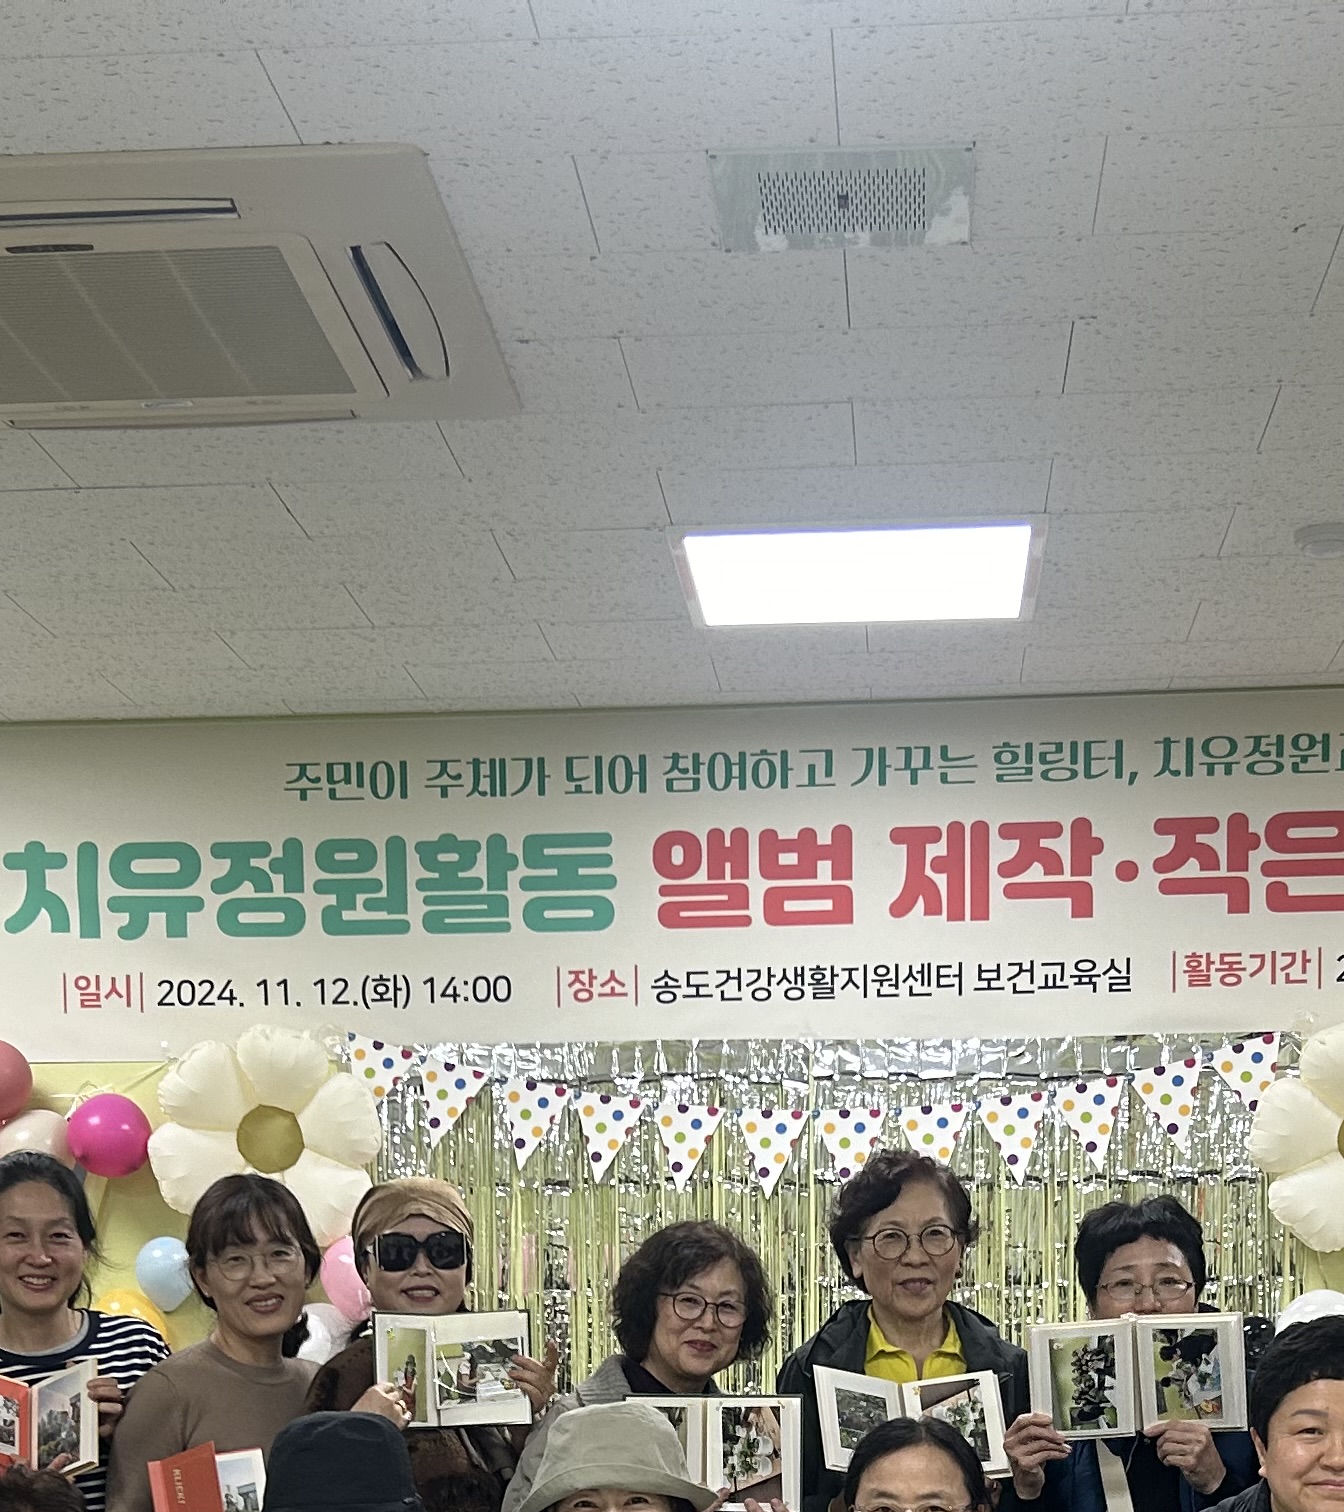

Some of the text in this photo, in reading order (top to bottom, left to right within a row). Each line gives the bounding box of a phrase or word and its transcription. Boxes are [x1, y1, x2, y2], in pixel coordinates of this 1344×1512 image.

[283, 759, 409, 802] 주민이
[424, 756, 551, 799] 주체가
[564, 753, 648, 796] 되어
[661, 750, 837, 793] 참여하고
[850, 743, 979, 787] 가꾸는
[991, 736, 1140, 787] 힐링터,
[2, 833, 618, 941] 치유정원활동
[651, 823, 854, 930] 앨범
[73, 973, 132, 1009] 일시
[156, 978, 245, 1008] 2024.
[255, 978, 302, 1008] 11.
[312, 973, 411, 1011] 12.(화)
[422, 974, 512, 1005] 14:00
[567, 967, 629, 1004] 장소
[650, 961, 963, 1005] 송도건강생활지원센터
[972, 956, 1132, 995] 보건교육실
[1182, 949, 1312, 988] 활동기간
